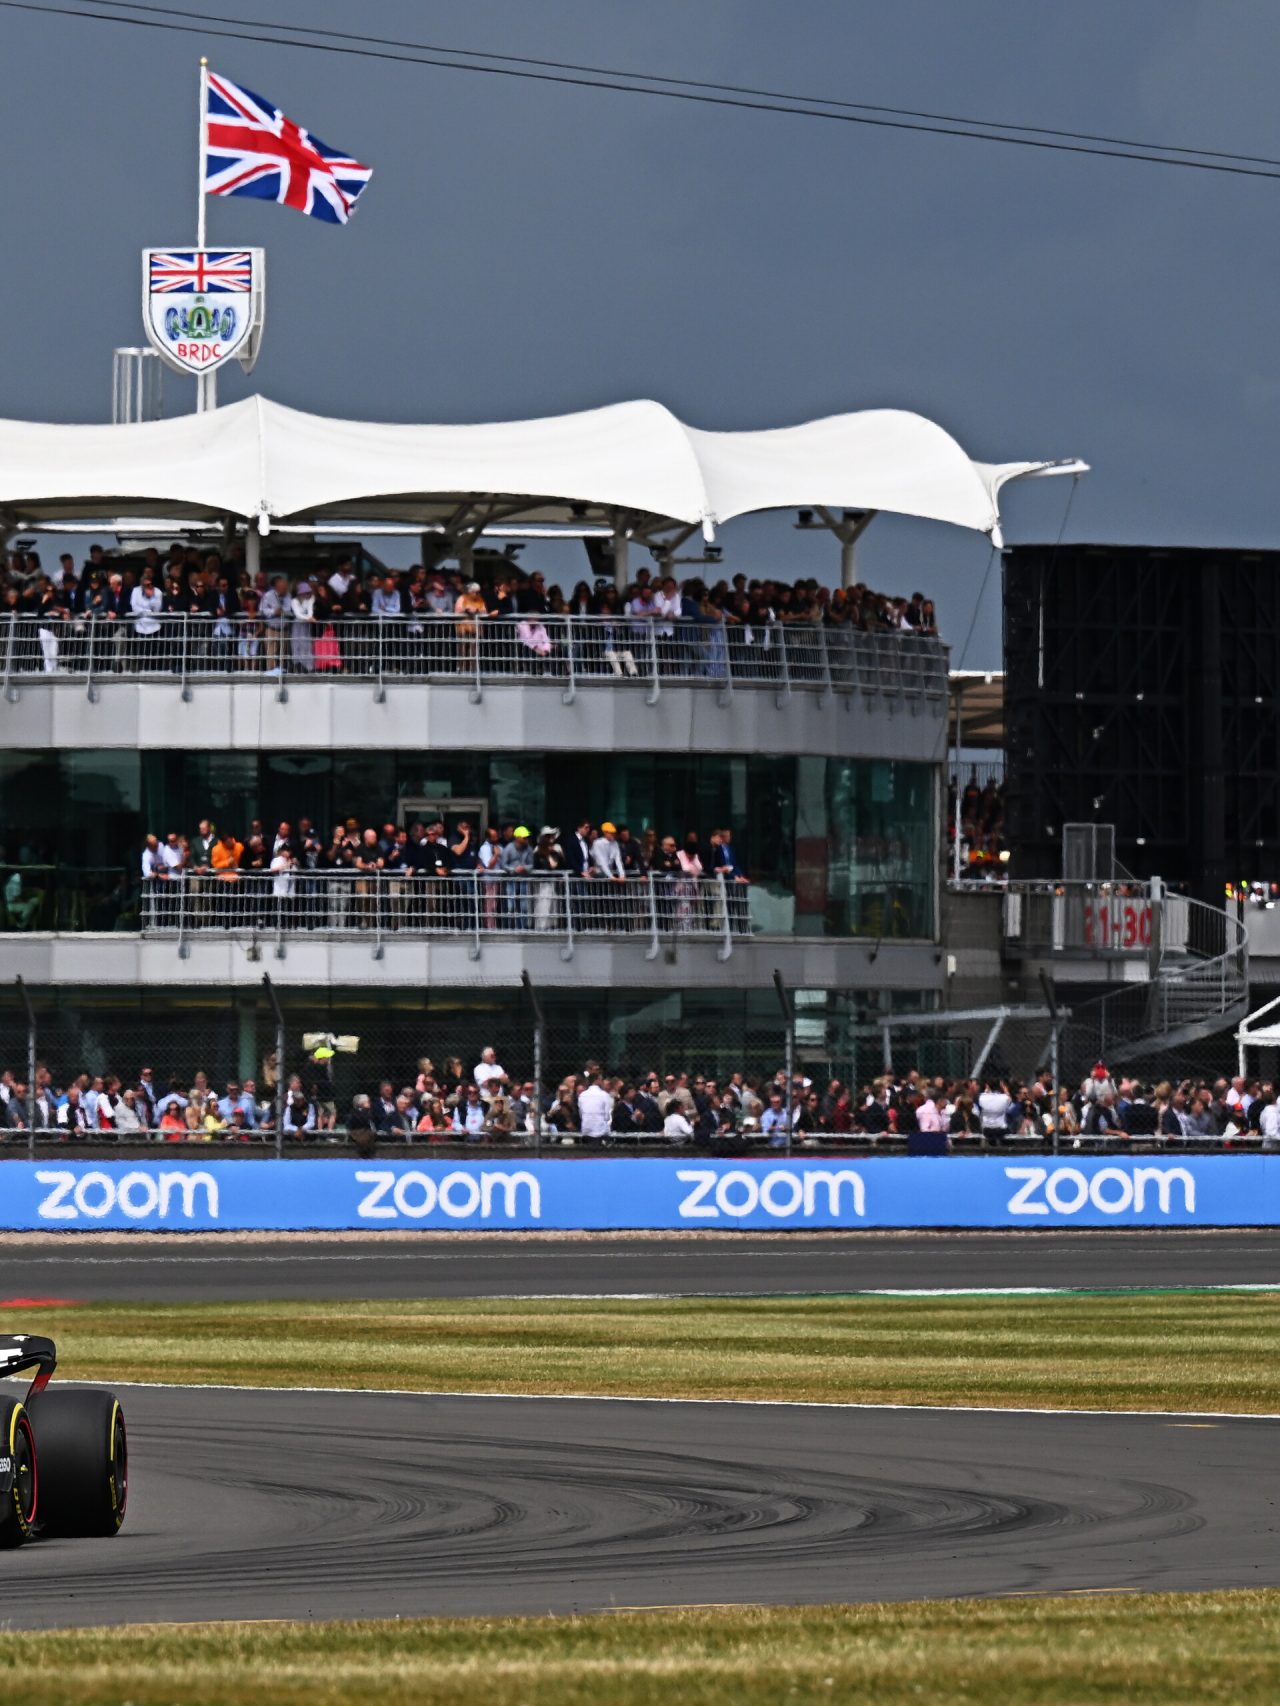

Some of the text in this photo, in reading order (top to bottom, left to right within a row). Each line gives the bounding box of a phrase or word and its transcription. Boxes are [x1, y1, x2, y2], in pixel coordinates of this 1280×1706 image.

[177, 343, 222, 363] BRDC
[34, 1171, 219, 1219] zoom
[355, 1170, 541, 1219] zoom
[676, 1169, 865, 1218] zoom
[1005, 1167, 1196, 1215] zoom
